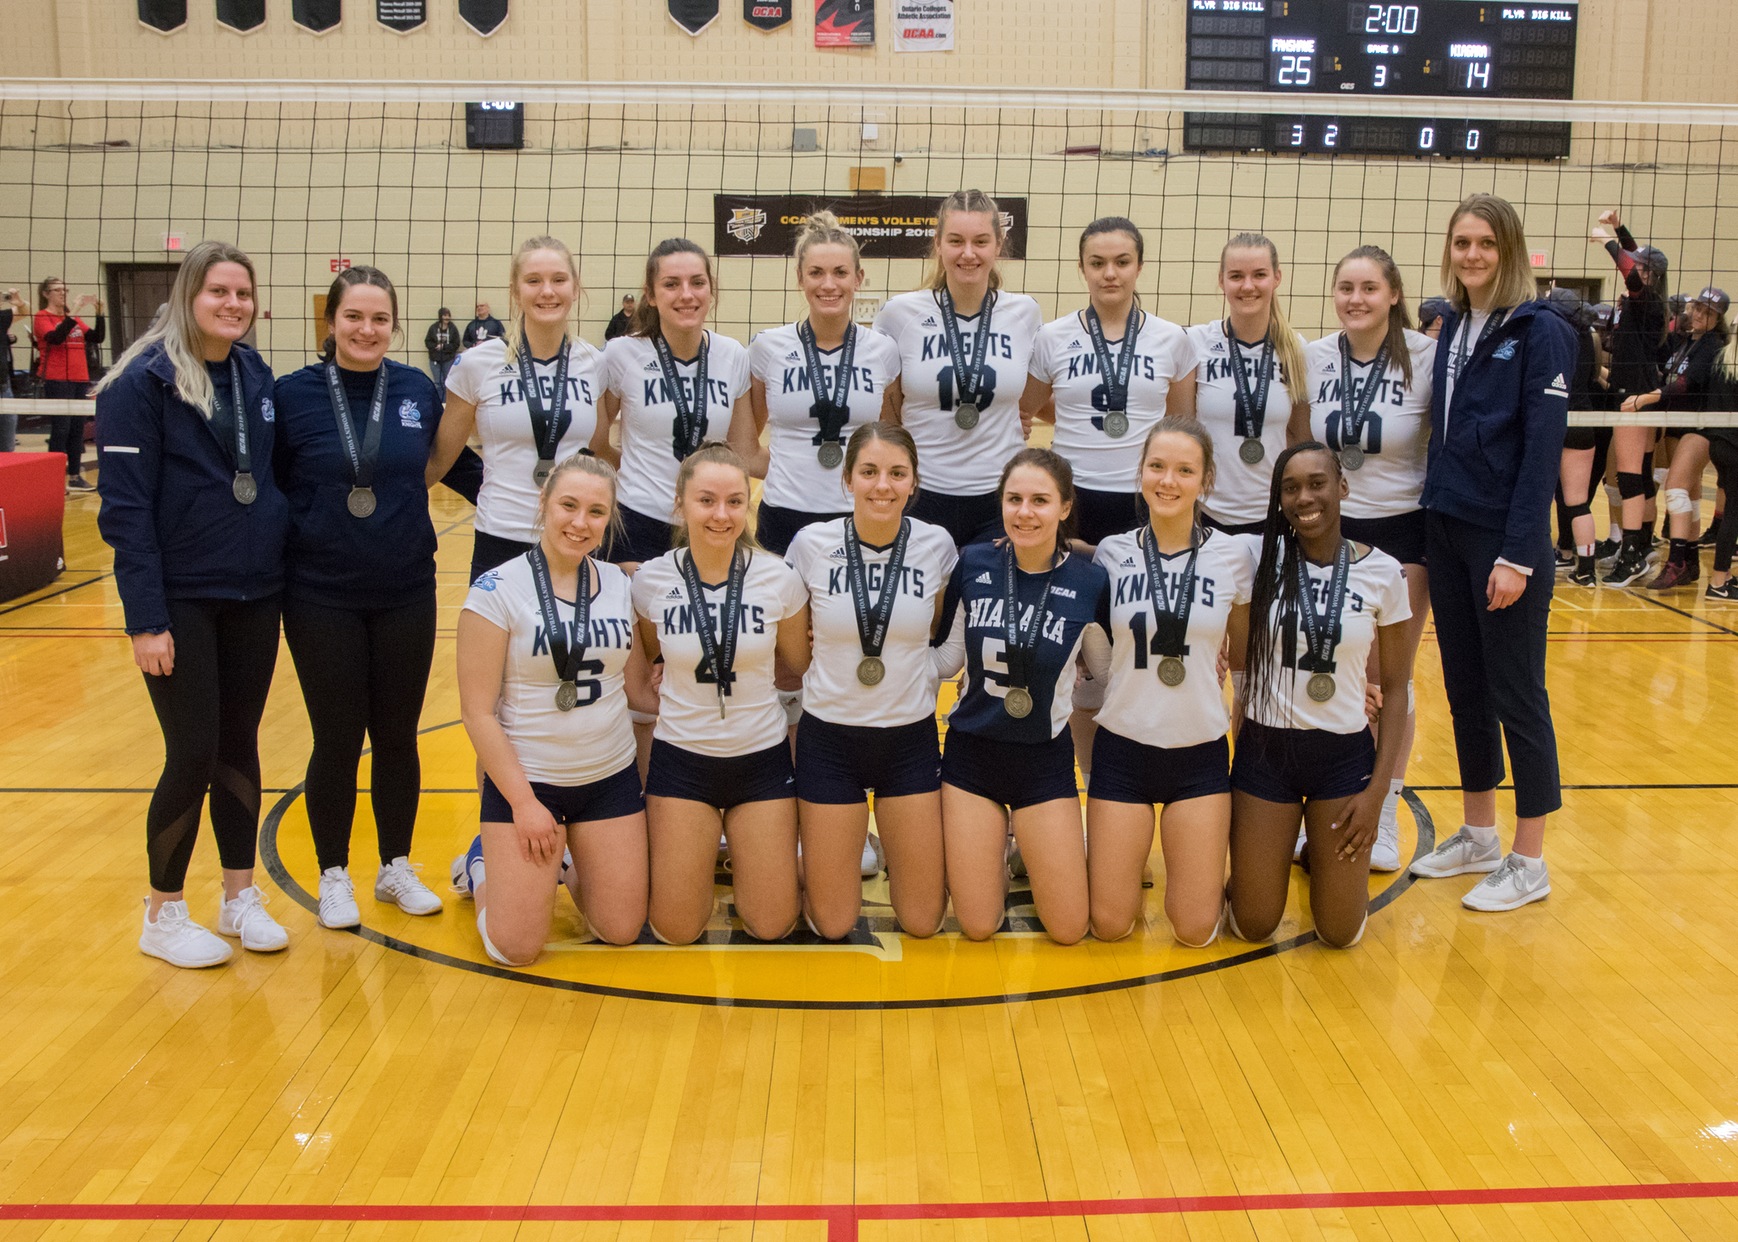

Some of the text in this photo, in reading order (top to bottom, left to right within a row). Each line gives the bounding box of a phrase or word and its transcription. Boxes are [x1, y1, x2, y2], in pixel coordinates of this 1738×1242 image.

[752, 6, 782, 17] OCAA
[1241, 2, 1264, 11] KILL
[1502, 9, 1525, 19] PLYR
[1550, 10, 1572, 21] KILL
[1366, 5, 1419, 33] 2:00
[1278, 55, 1311, 85] 25
[1373, 65, 1386, 87] 3
[1466, 62, 1490, 89] 14
[1290, 124, 1302, 146] 3
[1324, 124, 1338, 146] 2
[1420, 127, 1434, 148] 0
[1466, 129, 1480, 150] 0
[780, 216, 807, 225] OCA
[372, 401, 382, 422] OCAA
[1154, 589, 1166, 611] OCAA
[577, 623, 586, 644] OCAA
[872, 624, 885, 647] OCAA
[1009, 622, 1017, 645] OCAA
[1129, 612, 1190, 670] 14
[1321, 638, 1332, 660] OCAA
[981, 636, 1015, 700] 5
